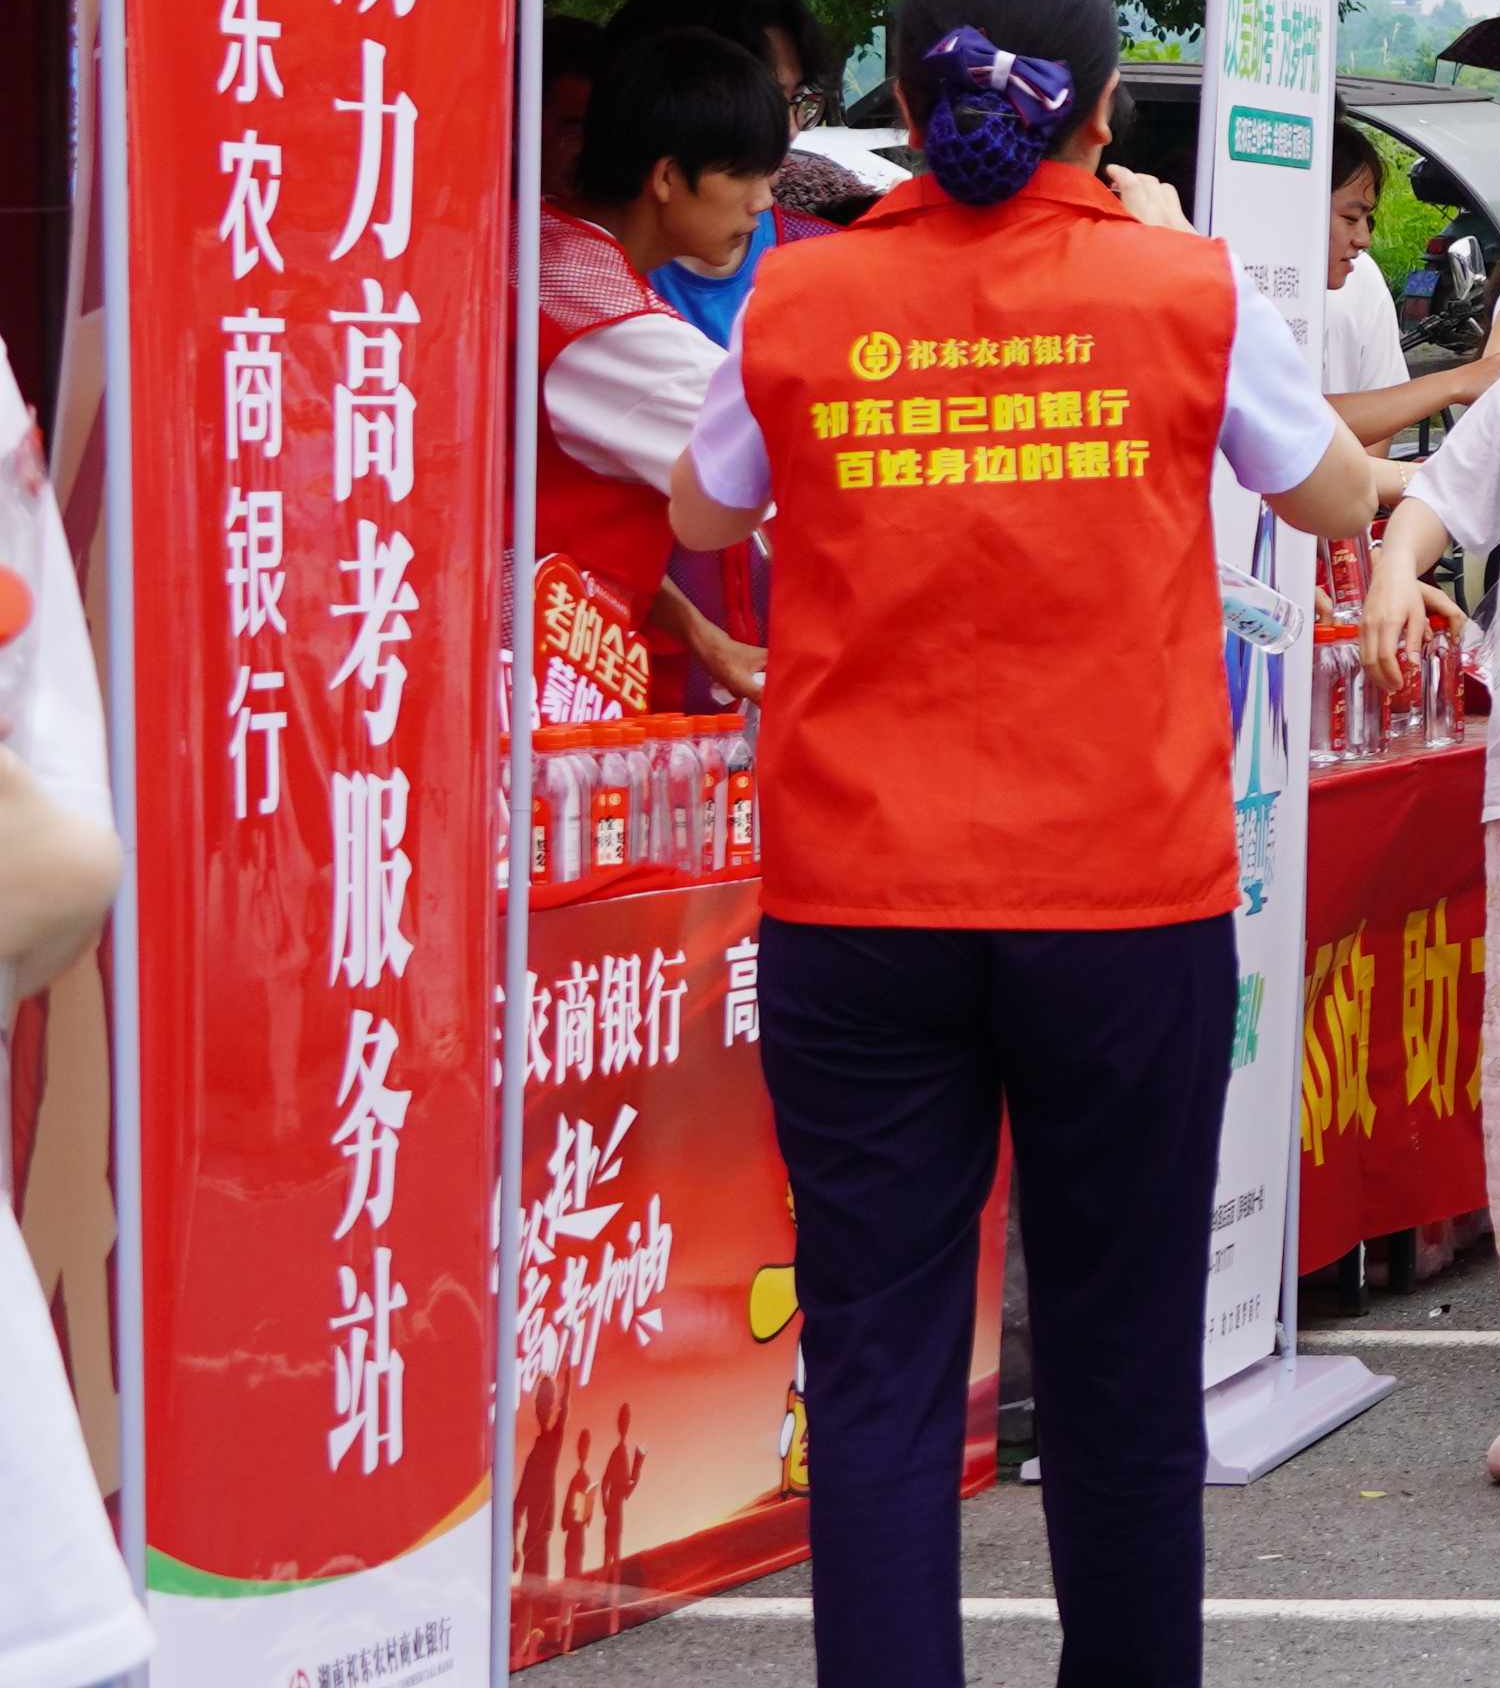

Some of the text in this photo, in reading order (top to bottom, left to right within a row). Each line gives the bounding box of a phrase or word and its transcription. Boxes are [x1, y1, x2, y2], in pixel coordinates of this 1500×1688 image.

[907, 334, 1096, 370] 祁东农商银行
[811, 388, 1131, 439] 祁东自己的银行
[836, 439, 1151, 489] 百姓身边的银行
[493, 946, 689, 1087] 农商银行
